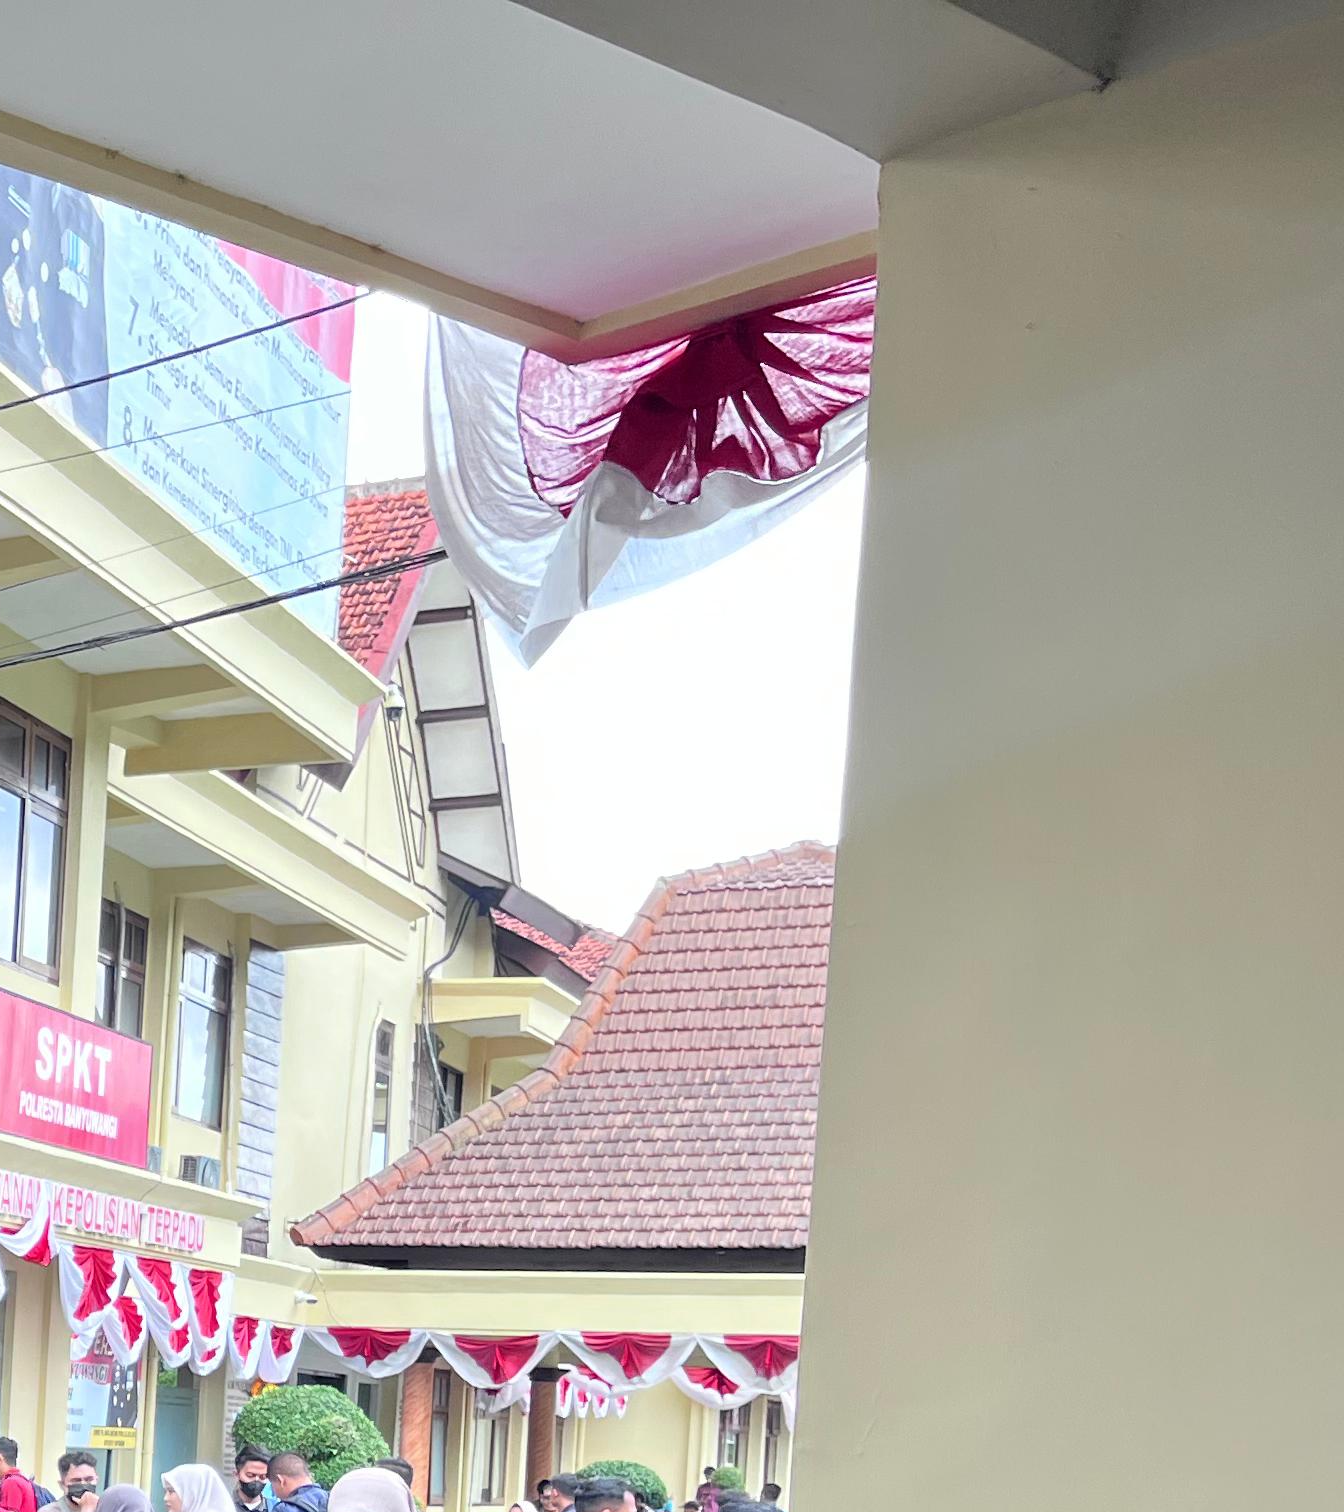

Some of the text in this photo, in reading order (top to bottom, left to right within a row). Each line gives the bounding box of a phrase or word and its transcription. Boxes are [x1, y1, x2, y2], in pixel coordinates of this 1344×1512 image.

[183, 245, 202, 280] dan
[142, 452, 160, 485] dan
[34, 1026, 112, 1097] SPKT
[19, 1090, 119, 1140] POLRESTA BANYUWANGI
[53, 1183, 141, 1239] KEPOLISIAN
[147, 1206, 206, 1252] TERPADU
